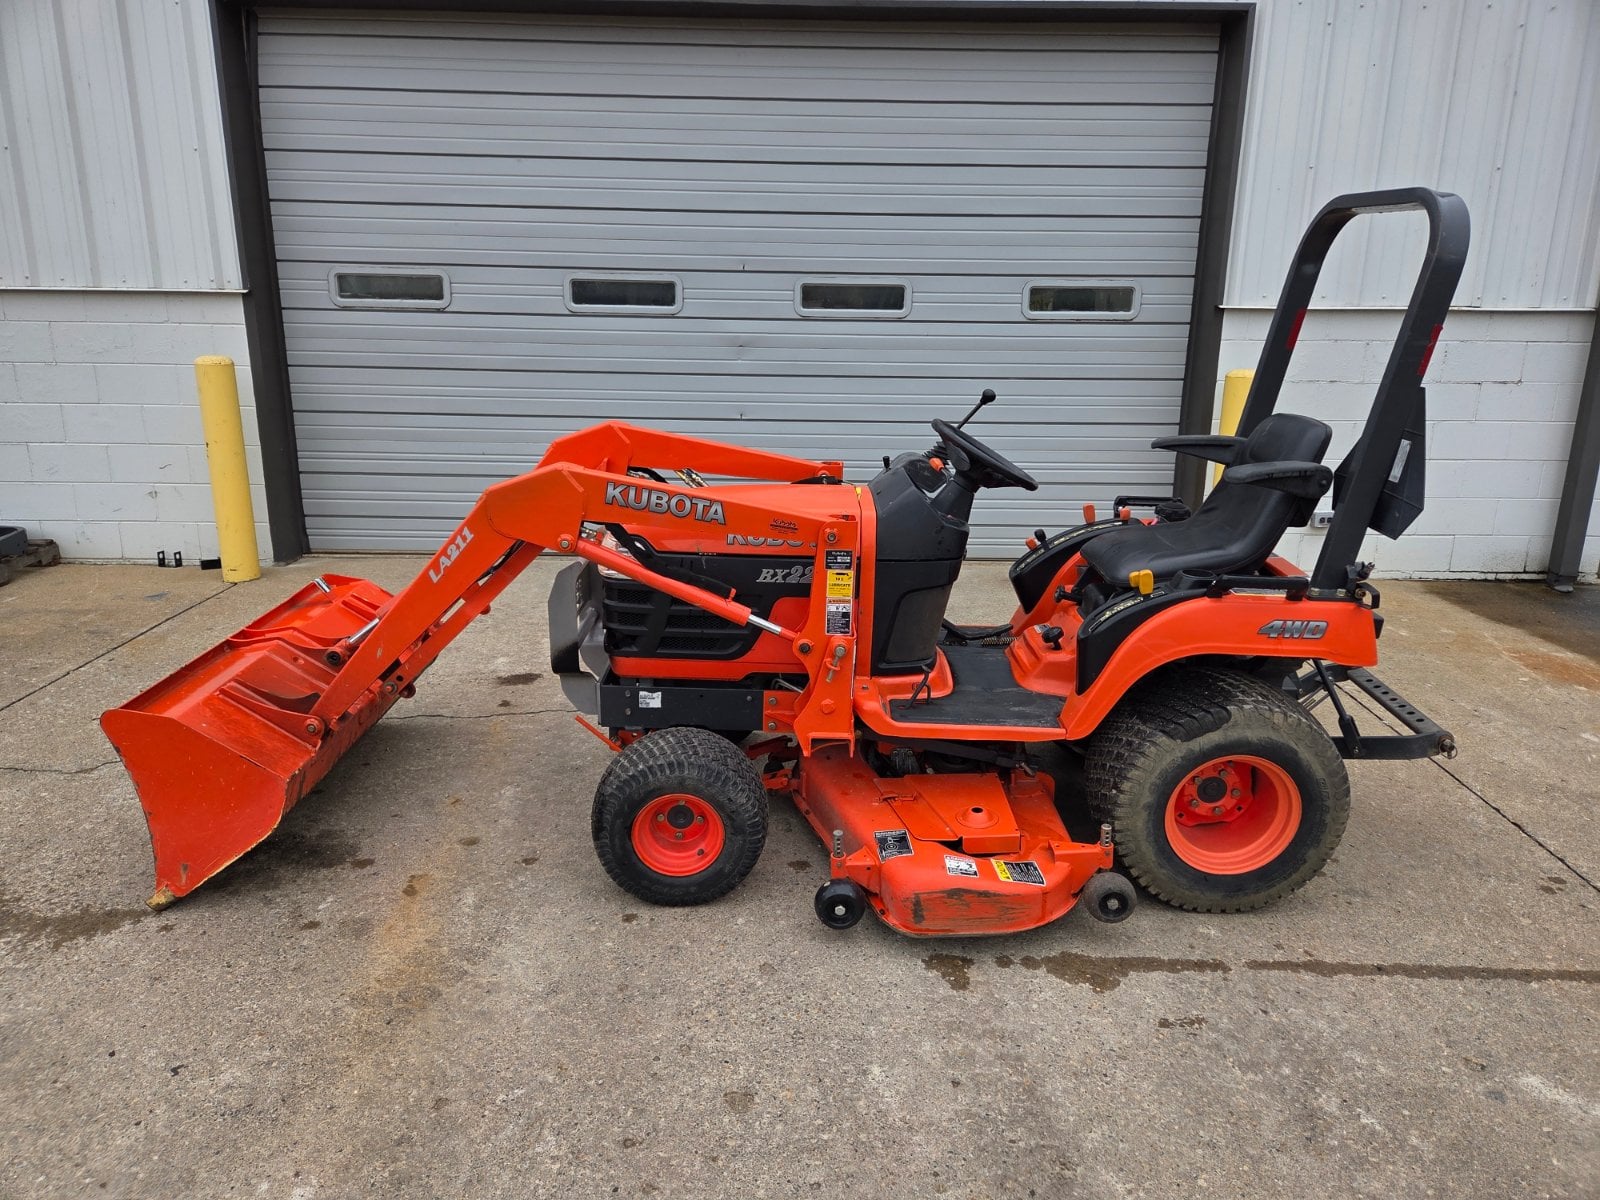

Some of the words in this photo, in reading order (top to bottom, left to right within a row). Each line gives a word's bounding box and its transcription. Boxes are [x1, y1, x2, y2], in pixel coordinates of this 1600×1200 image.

[605, 482, 726, 525] KUBOTA
[428, 526, 474, 584] LA211
[1257, 619, 1328, 639] 4WD
